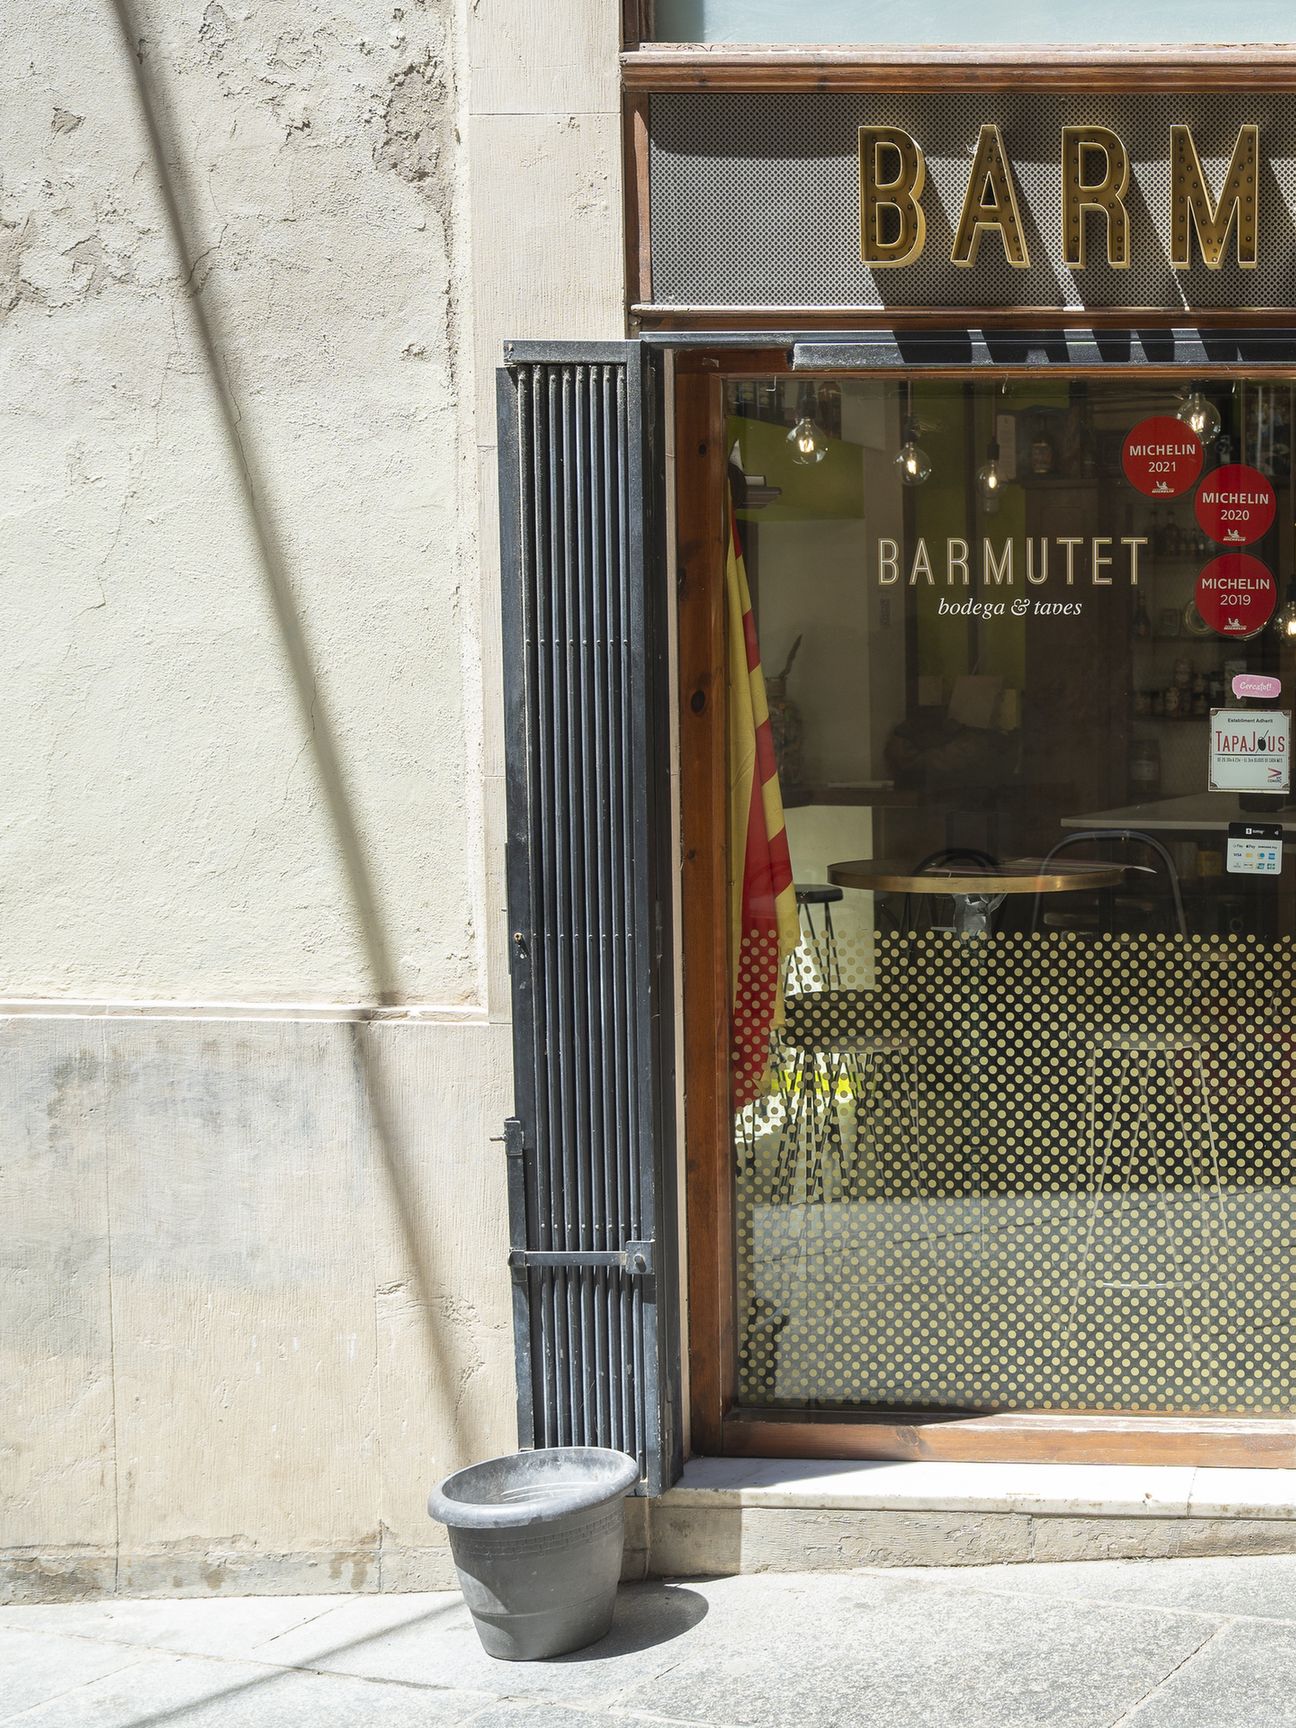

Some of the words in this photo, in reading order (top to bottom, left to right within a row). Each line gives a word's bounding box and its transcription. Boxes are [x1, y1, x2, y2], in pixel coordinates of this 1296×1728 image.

[1129, 444, 1196, 456] MICHELIN
[1148, 461, 1176, 473] 2021
[1202, 492, 1269, 504] MICHELIN
[1220, 509, 1250, 521] 2020
[878, 537, 1148, 586] BARMUTET
[1202, 578, 1270, 590] MICHELIN
[1220, 594, 1251, 606] 2019
[938, 597, 1005, 620] bodega
[1010, 598, 1031, 616] &
